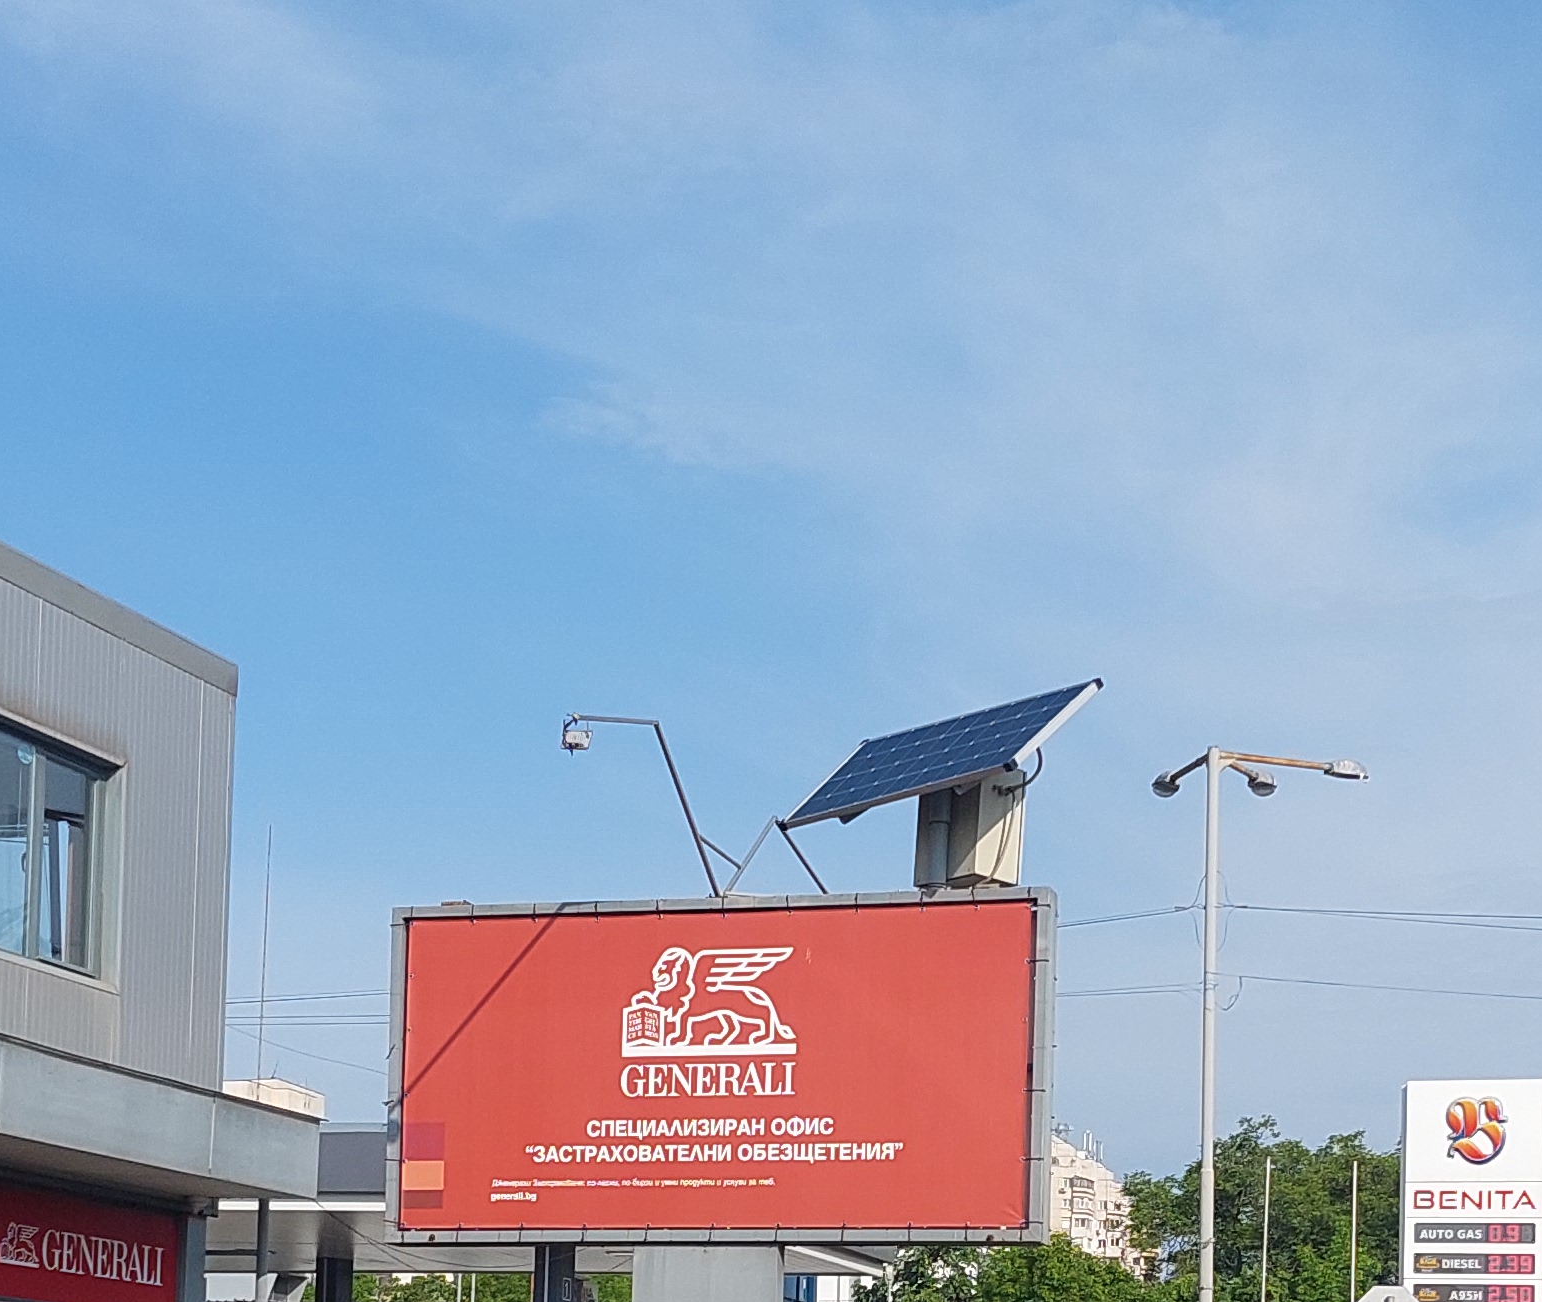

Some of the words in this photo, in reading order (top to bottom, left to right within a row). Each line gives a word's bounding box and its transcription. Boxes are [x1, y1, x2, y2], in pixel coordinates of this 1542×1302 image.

[620, 1061, 796, 1098] GENERALI
[586, 1118, 765, 1141] СПЕЦИАЛИЗИРАН
[770, 1116, 834, 1137] ОФИС
[1413, 1189, 1537, 1210] BENITA
[1419, 1229, 1454, 1240] AUTO
[1457, 1229, 1483, 1240] GAS
[41, 1229, 164, 1287] GENERALI
[1441, 1258, 1482, 1269] DIESEL
